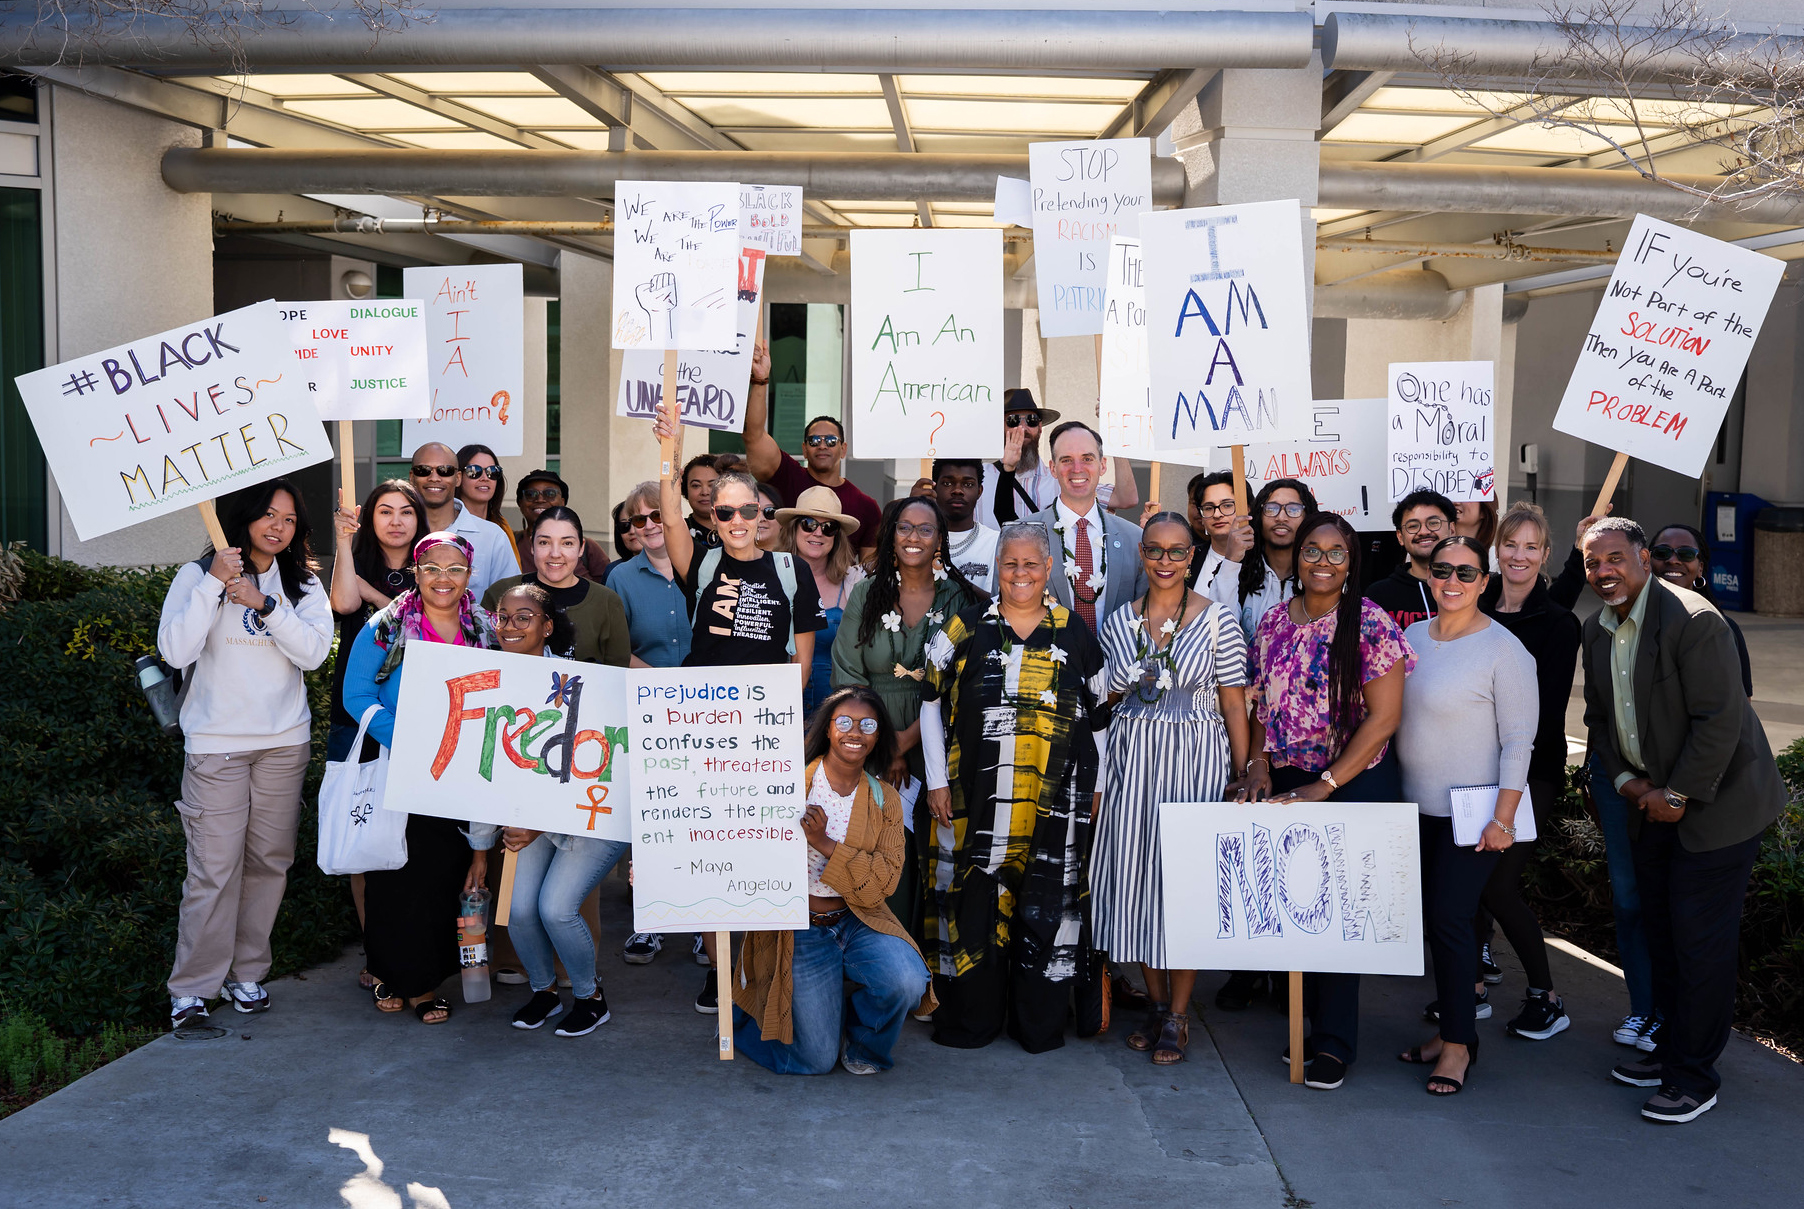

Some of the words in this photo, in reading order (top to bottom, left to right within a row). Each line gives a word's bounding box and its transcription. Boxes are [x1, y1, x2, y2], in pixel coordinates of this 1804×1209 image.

[1056, 147, 1119, 183] STOP
[623, 192, 656, 221] WE
[662, 211, 690, 223] ARE
[1033, 187, 1108, 215] Pretending
[634, 219, 659, 244] WE
[654, 247, 676, 262] ARE
[675, 235, 703, 251] THE
[1057, 218, 1118, 241] RACISM
[1079, 251, 1096, 271] IS
[1185, 214, 1245, 283] I
[903, 252, 936, 293] I
[1115, 243, 1144, 288] THE
[433, 277, 478, 305] Ain't
[279, 309, 308, 321] OPE
[350, 307, 418, 319] DIALOGUE
[1106, 299, 1119, 325] A
[1174, 279, 1268, 337] AM
[1610, 279, 1642, 301] Not
[1646, 291, 1688, 317] Part
[1693, 310, 1718, 324] of
[1724, 312, 1753, 339] the
[312, 328, 349, 340] LOVE
[446, 310, 470, 343] I
[872, 314, 920, 354] Am
[932, 313, 975, 346] An
[62, 322, 241, 396] #BLACK
[294, 348, 319, 359] IDE
[350, 345, 394, 356] UNITY
[442, 345, 469, 378] A
[1205, 337, 1244, 386] A
[677, 362, 702, 383] the
[1586, 333, 1618, 359] Then
[1684, 368, 1697, 386] A
[1696, 374, 1727, 399] Part
[350, 378, 408, 390] JUSTICE
[870, 361, 992, 416] American
[1396, 372, 1451, 403] One
[1461, 380, 1491, 406] has
[1628, 374, 1652, 391] of
[1651, 379, 1674, 401] the
[1171, 384, 1279, 440] MAN
[1586, 390, 1689, 441] PROBLEM
[1392, 414, 1403, 430] a
[1415, 407, 1486, 446] Moral
[120, 412, 305, 504] MATTER
[1263, 448, 1352, 481] ALWAYS
[1392, 449, 1459, 467] responsibility
[1469, 447, 1489, 461] to
[1392, 467, 1480, 499] DISOBEY
[1713, 573, 1739, 587] MESA
[711, 572, 741, 621] AM
[734, 618, 774, 629] POWERFUL.
[736, 606, 774, 617] RESILIENT.
[1388, 610, 1439, 628] VICT
[637, 682, 740, 705] prejudice
[746, 684, 766, 701] is
[642, 713, 653, 724] a
[667, 708, 742, 725] burden
[753, 706, 795, 726] that
[642, 733, 739, 750] confuses
[751, 734, 780, 751] the
[703, 757, 792, 773] threatens
[646, 784, 679, 800] the
[696, 782, 759, 799] future
[766, 782, 795, 795] and
[641, 804, 712, 822] renders
[724, 803, 756, 819] the
[760, 804, 801, 824] pres-
[641, 829, 675, 844] ent
[688, 827, 799, 843] inaccessible.
[690, 858, 734, 876] Maya
[726, 879, 792, 896] Angelou
[1216, 822, 1414, 943] NOW
